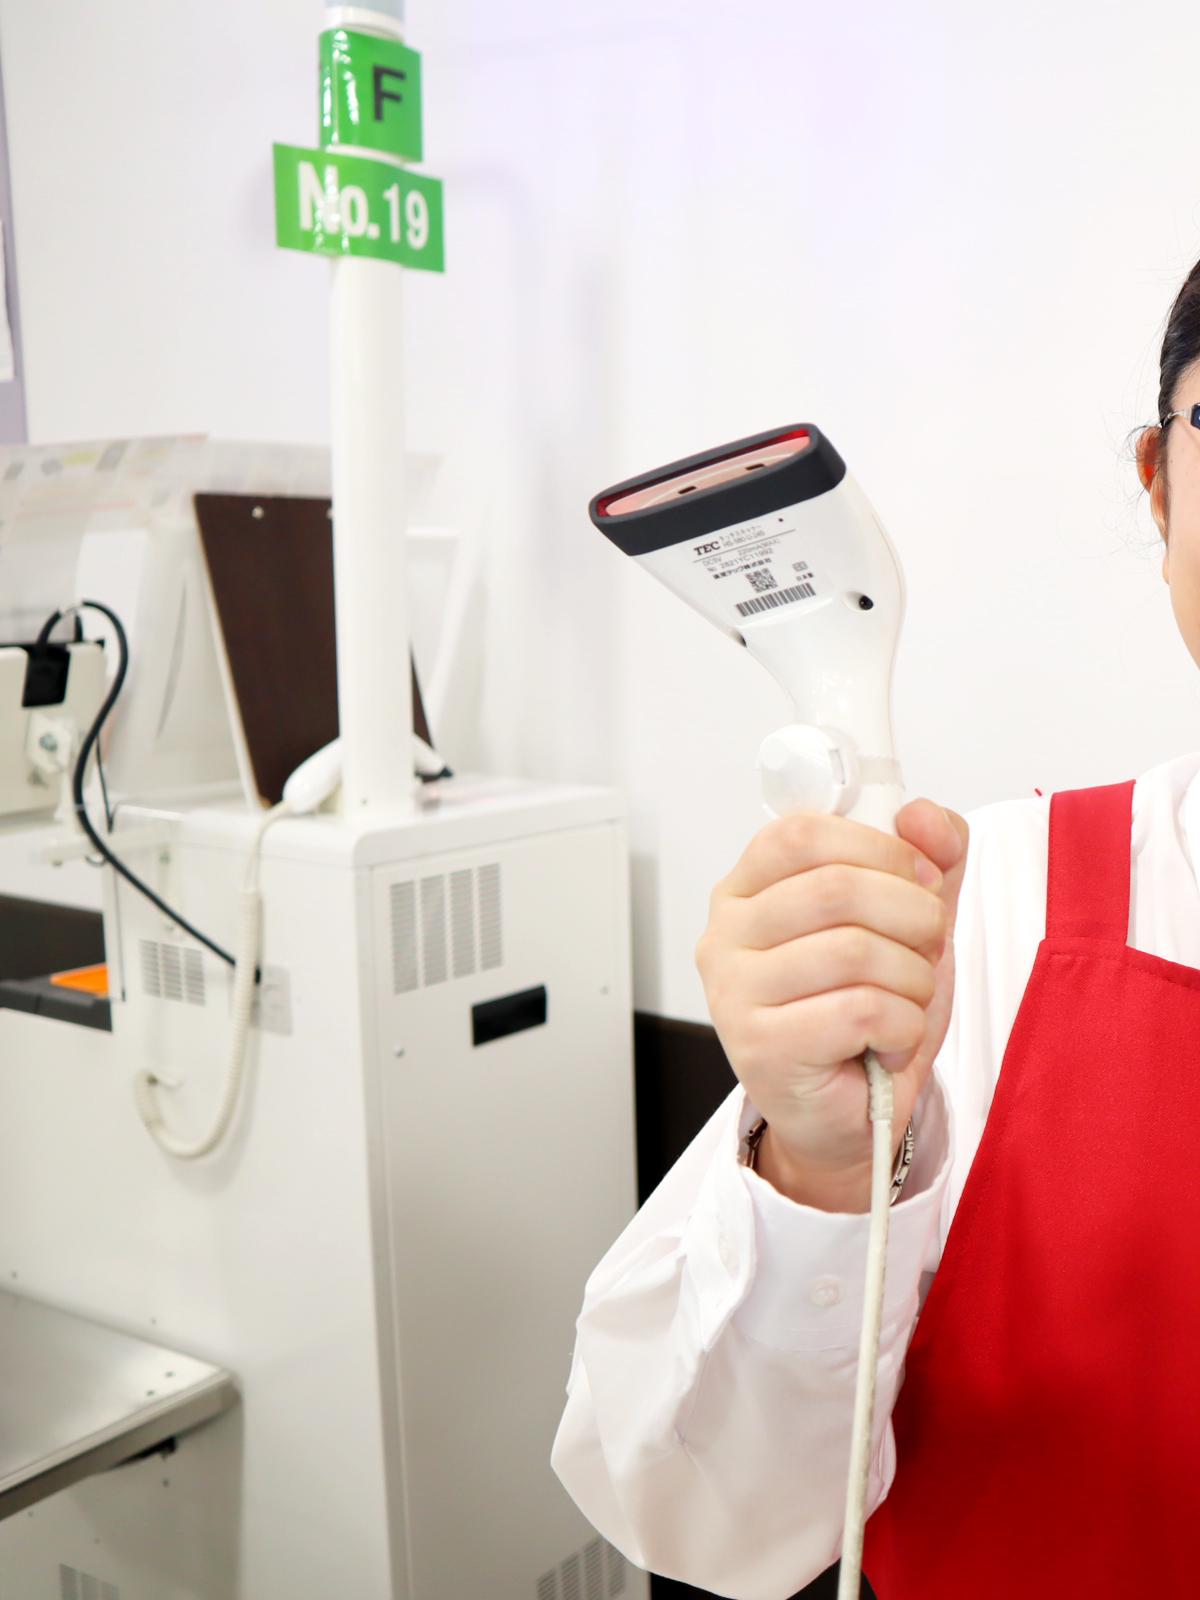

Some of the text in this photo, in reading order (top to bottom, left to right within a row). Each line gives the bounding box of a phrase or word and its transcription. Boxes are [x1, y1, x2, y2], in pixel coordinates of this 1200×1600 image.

[372, 64, 407, 122] F
[298, 160, 430, 250] No.19
[694, 541, 720, 556] TEC
